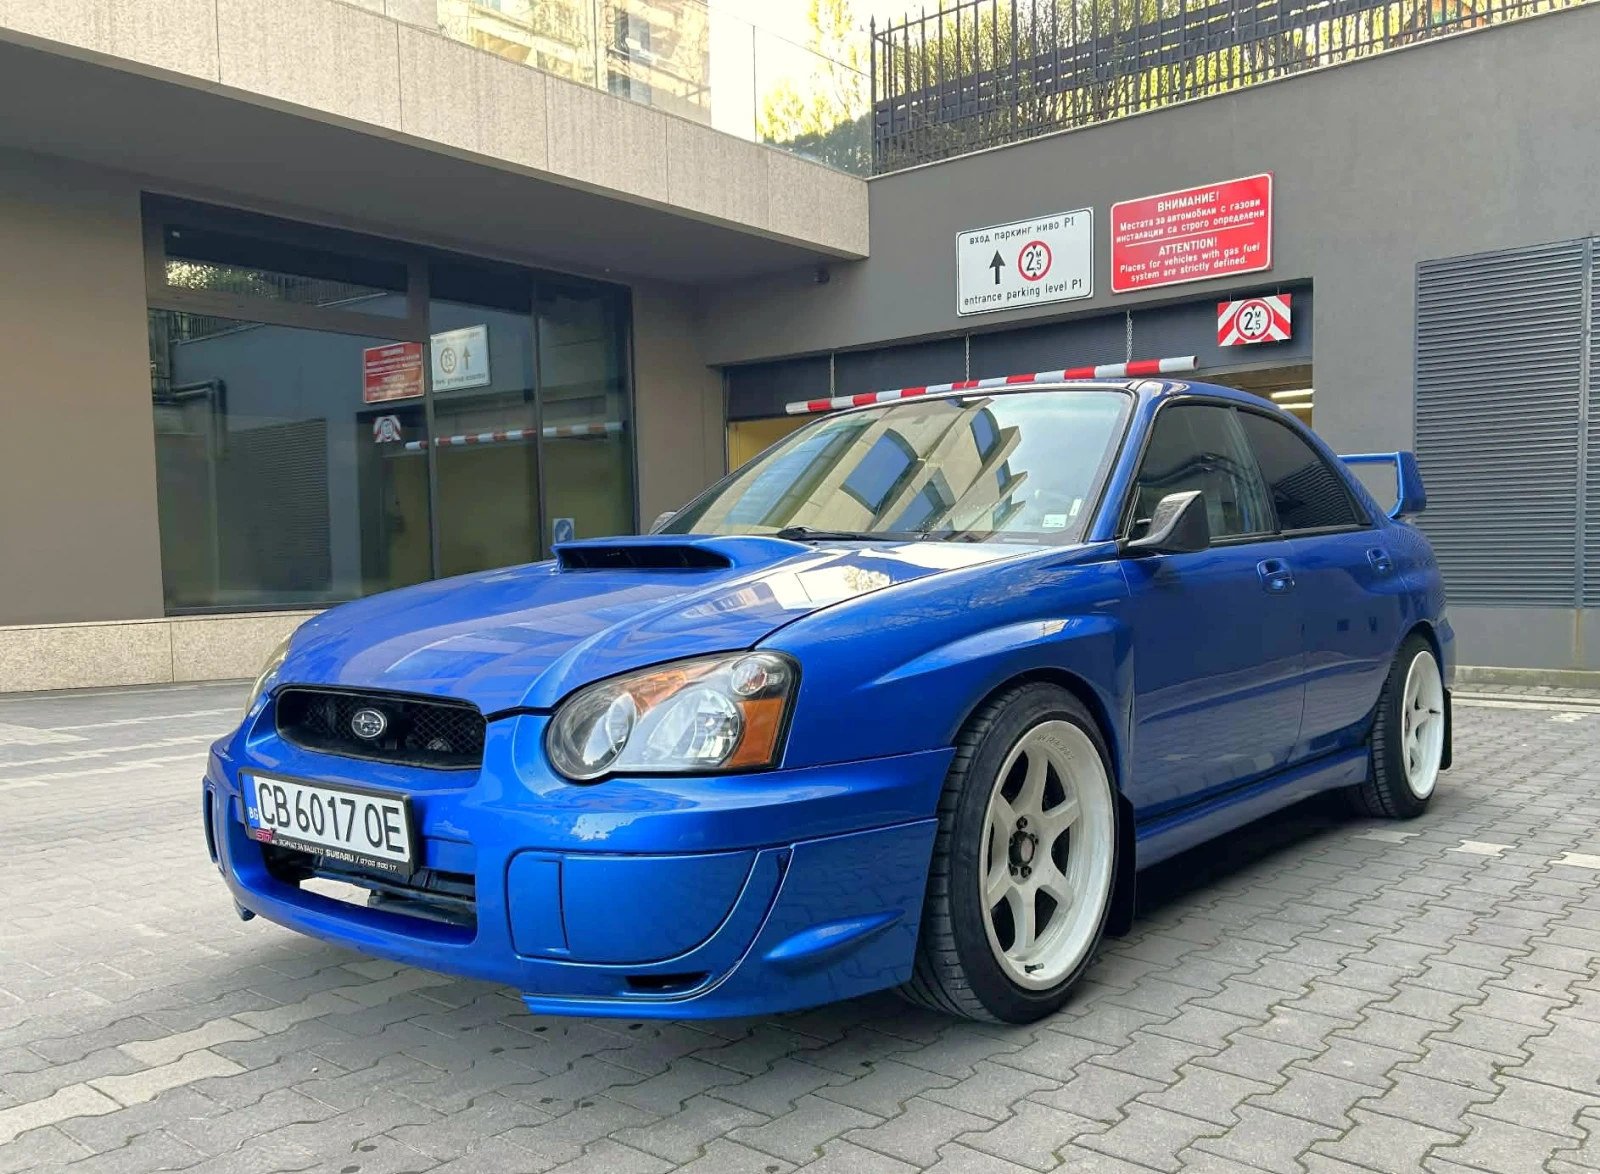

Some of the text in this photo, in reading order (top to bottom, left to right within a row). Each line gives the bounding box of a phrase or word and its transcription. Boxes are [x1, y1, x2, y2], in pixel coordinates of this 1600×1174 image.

[1120, 198, 1261, 231] Местата за автомобили с газови
[1157, 191, 1220, 212] ВНИМАНИЕ!
[969, 234, 990, 245] вход
[994, 226, 1032, 241] паркинг
[1036, 221, 1060, 233] ниво
[1116, 209, 1265, 243] инсталации са строго определени
[1120, 242, 1261, 274] Places for vehicles with gas fuel
[1158, 237, 1218, 256] ATTENTION!
[1130, 255, 1248, 283] system are strictly defined.
[964, 278, 1082, 306] entrance parking level P1
[248, 806, 259, 821] BG
[295, 790, 356, 843] 6017
[325, 849, 354, 862] SUBARU
